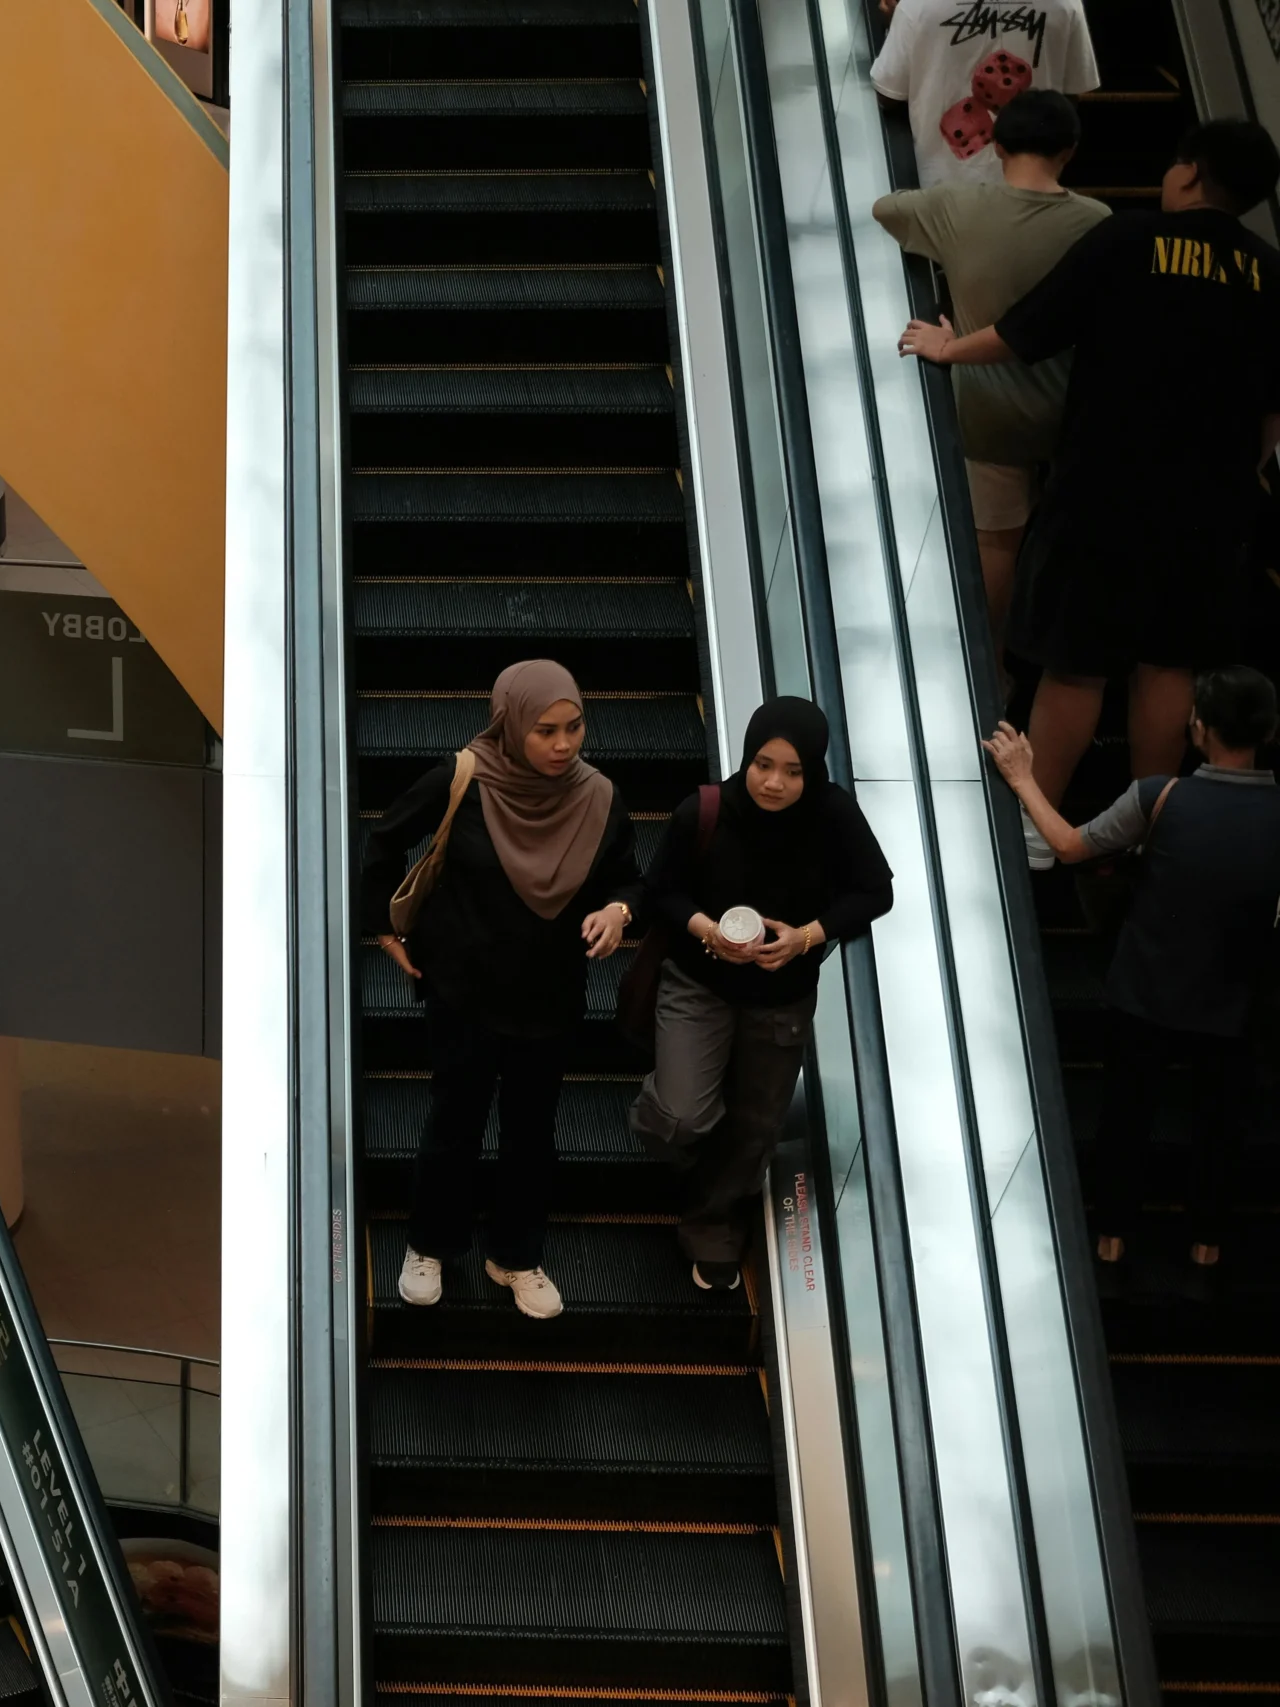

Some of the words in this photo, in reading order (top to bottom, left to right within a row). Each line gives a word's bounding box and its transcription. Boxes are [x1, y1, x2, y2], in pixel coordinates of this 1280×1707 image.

[782, 1196, 794, 1212] OF
[794, 1173, 809, 1214] PLEASE
[333, 1209, 342, 1240] SIDES
[784, 1215, 797, 1236] THE
[800, 1217, 812, 1252] STAND
[803, 1256, 816, 1292] CLEAR
[32, 1428, 74, 1549] LEVEL
[77, 1553, 87, 1577] 1
[22, 1440, 80, 1610] #01-51A
